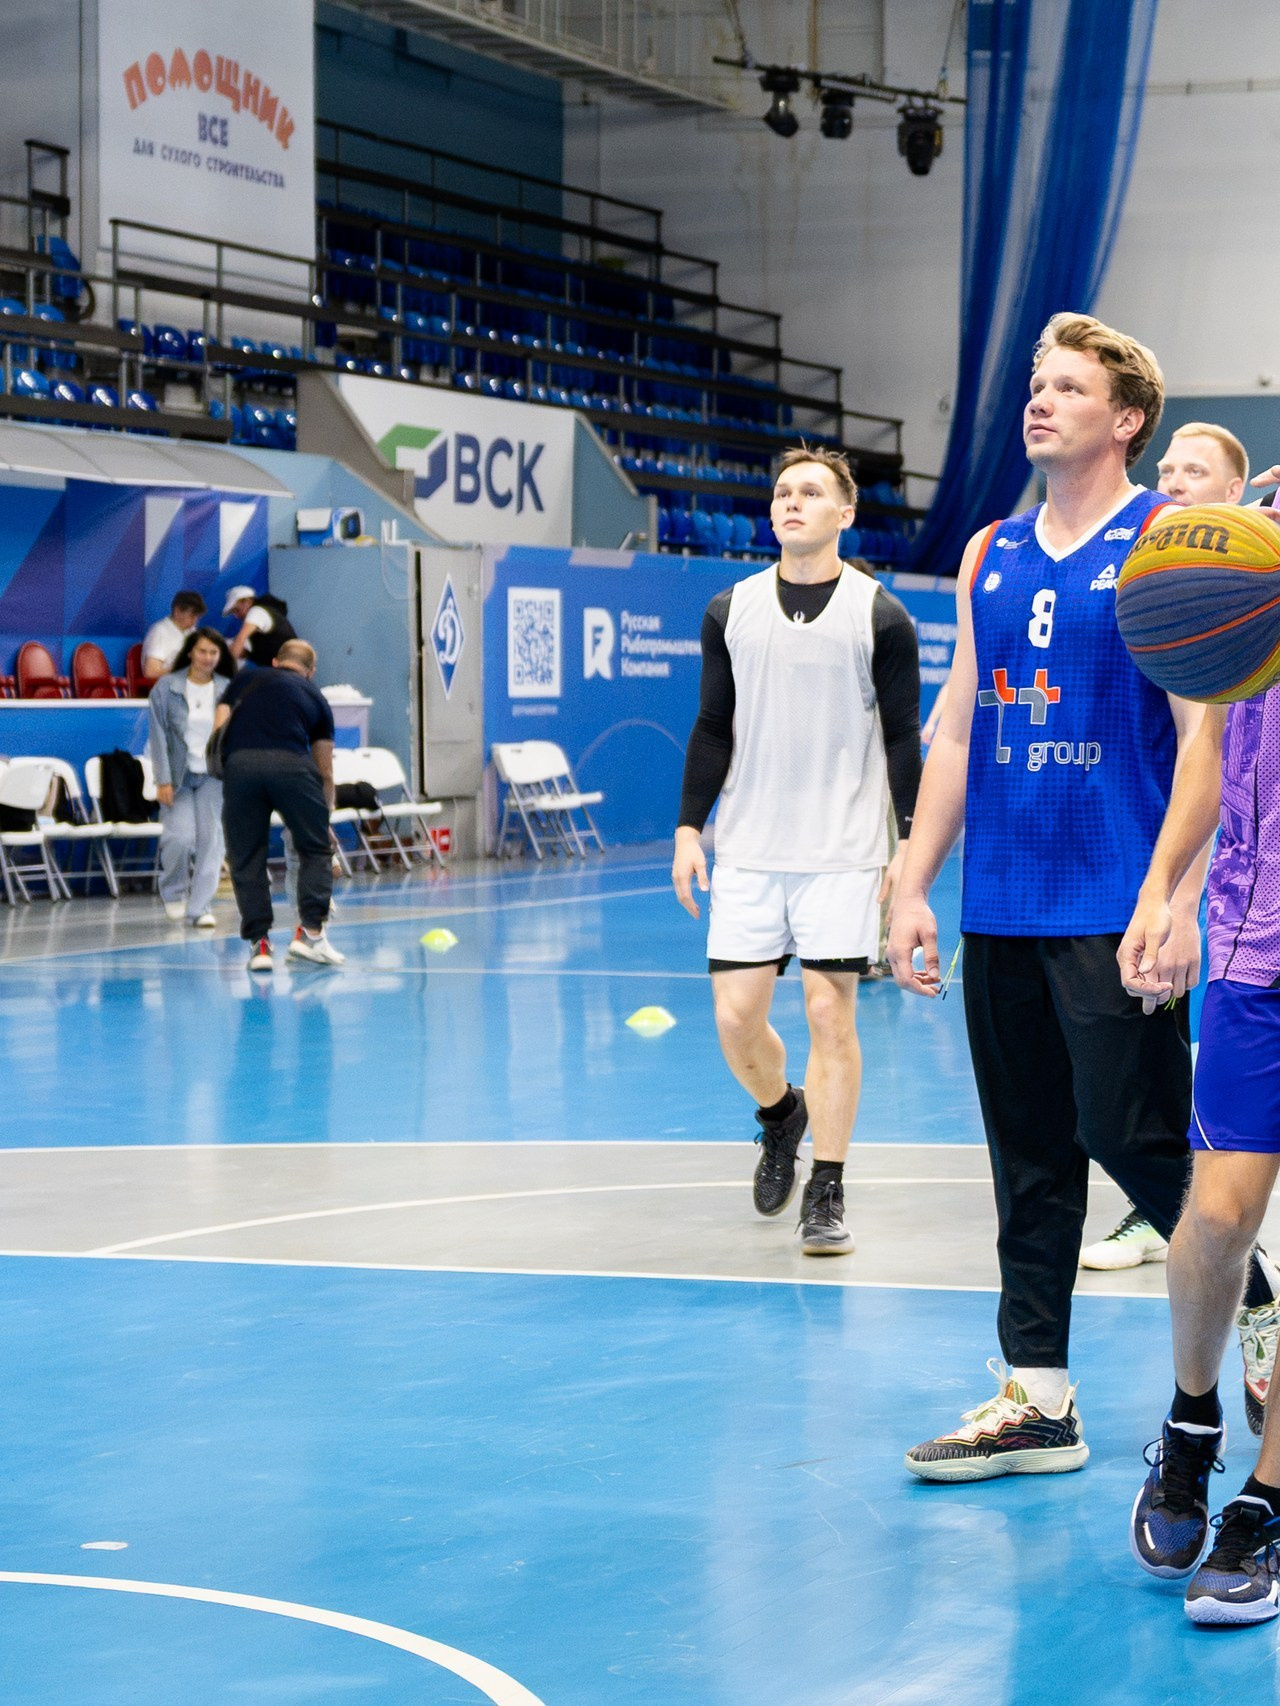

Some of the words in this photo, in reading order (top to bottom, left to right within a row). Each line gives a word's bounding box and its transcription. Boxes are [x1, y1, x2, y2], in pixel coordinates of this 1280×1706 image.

[123, 47, 295, 150] ПОМОЩНИК
[197, 112, 229, 147] ВСЕ
[132, 138, 154, 158] ДЛЯ
[161, 145, 201, 168] СУХОГО
[206, 157, 286, 189] СТРОИТЕЛЬСТВА
[454, 432, 545, 517] ВСК
[1028, 588, 1056, 648] 8
[1027, 741, 1101, 772] group
